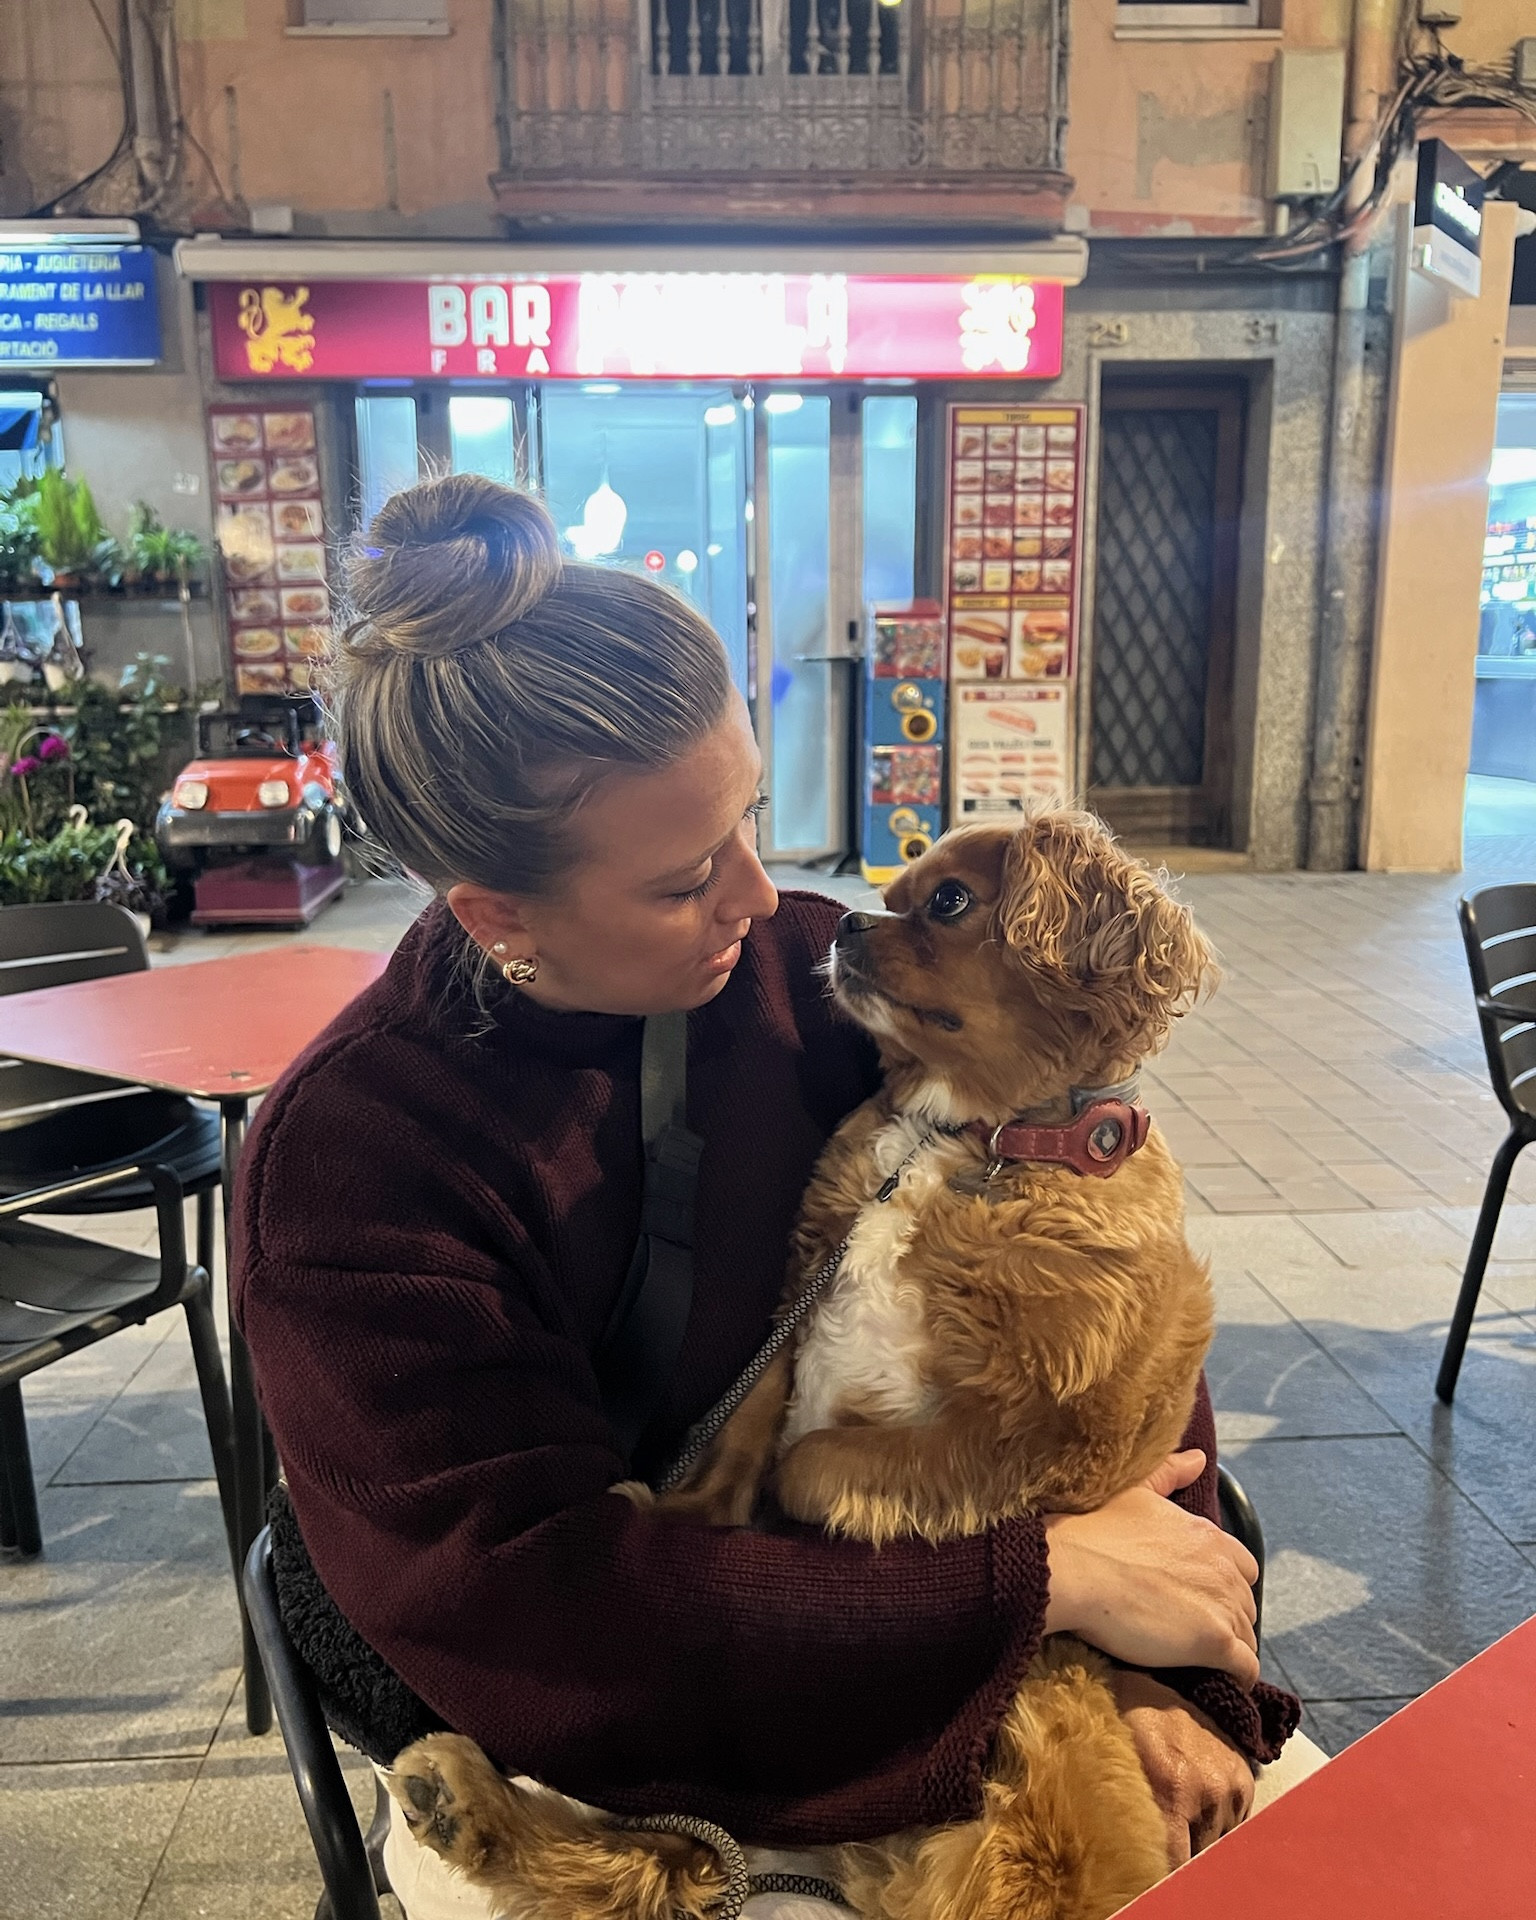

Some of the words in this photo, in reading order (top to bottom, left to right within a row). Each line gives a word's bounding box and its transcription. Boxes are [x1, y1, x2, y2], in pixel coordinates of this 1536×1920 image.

[34, 254, 122, 273] JUGUETERIA
[59, 282, 81, 301] DE
[83, 282, 104, 301] LA
[105, 282, 145, 301] LLAR
[34, 312, 99, 332] REGALS
[428, 284, 551, 347] BAR
